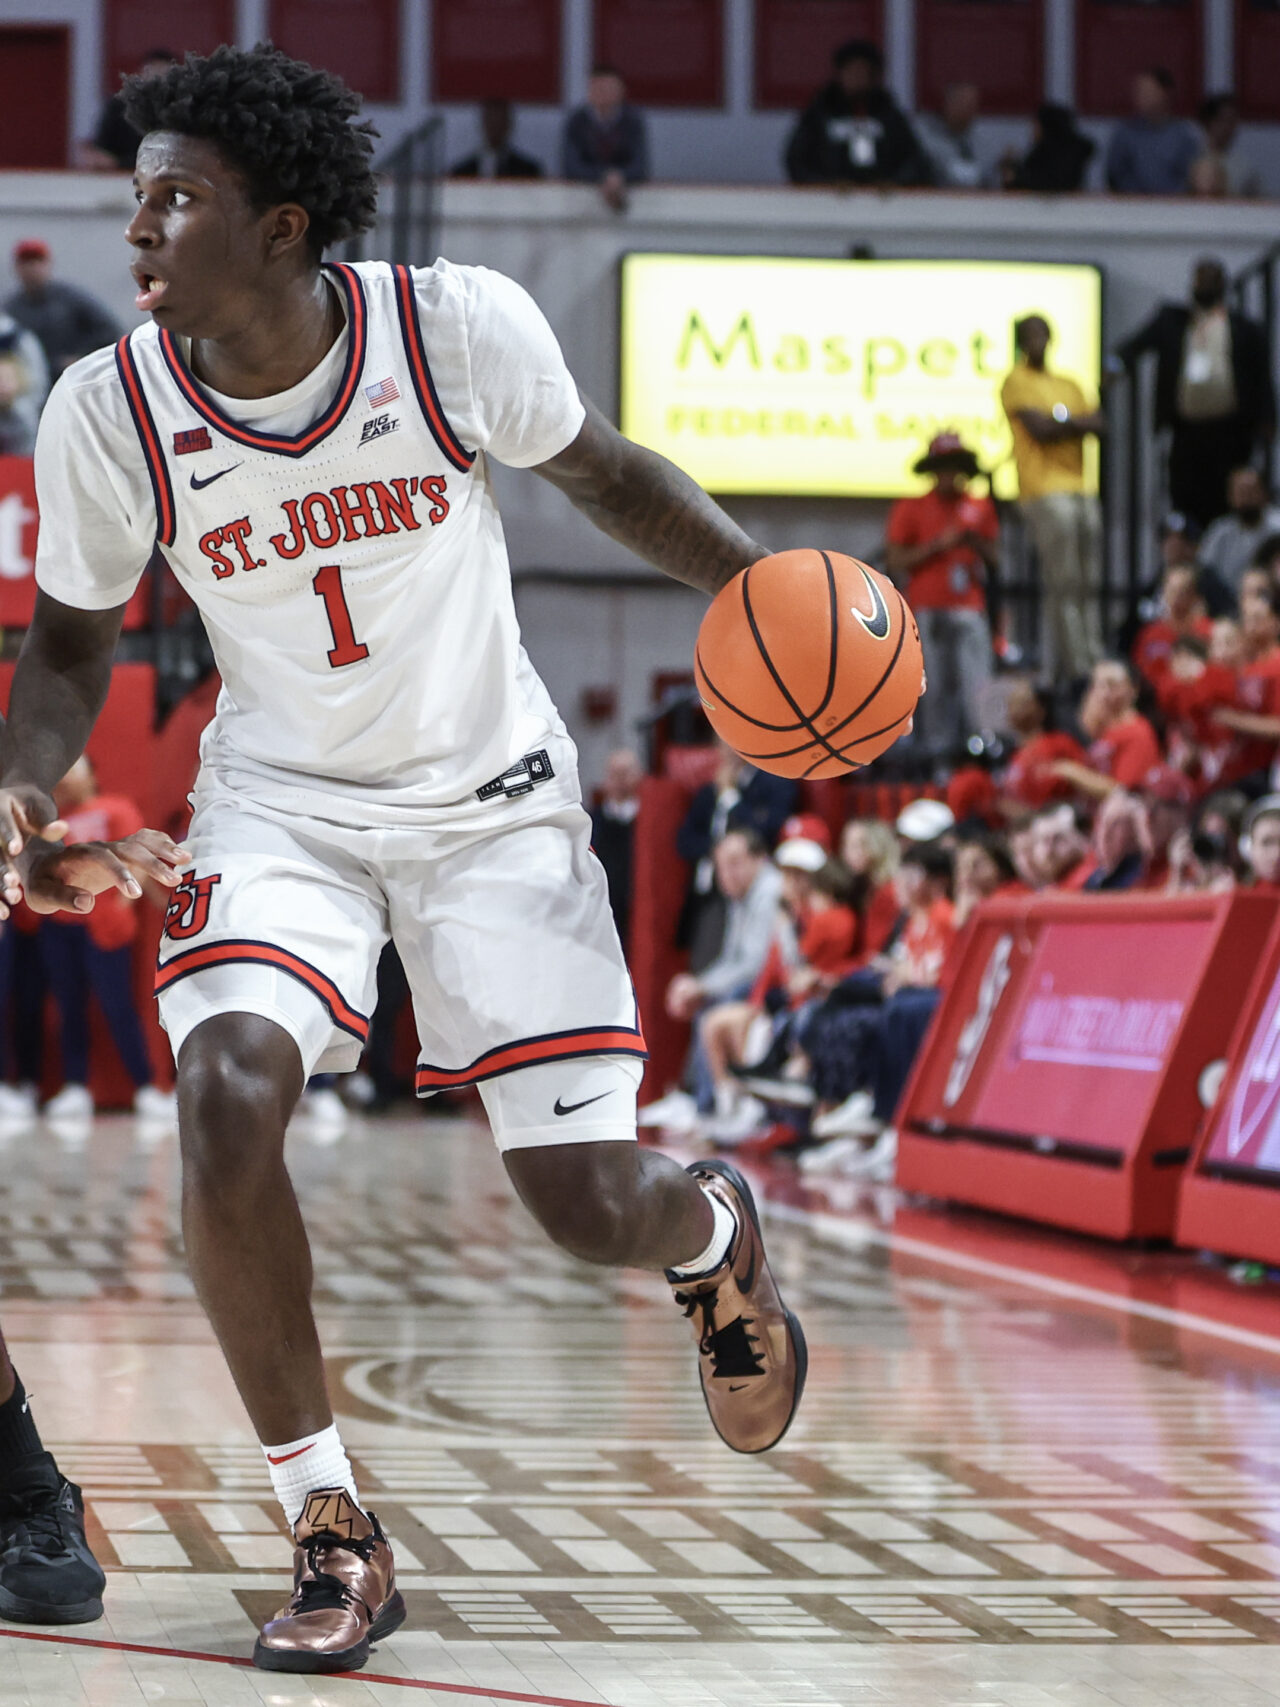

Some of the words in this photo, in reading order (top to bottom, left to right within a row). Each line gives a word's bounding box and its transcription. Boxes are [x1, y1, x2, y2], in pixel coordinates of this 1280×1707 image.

[674, 308, 1022, 402] Maspet
[360, 418, 400, 440] EAST
[363, 413, 389, 431] BIG
[199, 516, 267, 580] ST.
[269, 475, 450, 560] JOHN'S
[312, 565, 370, 668] 1
[531, 760, 542, 773] 46
